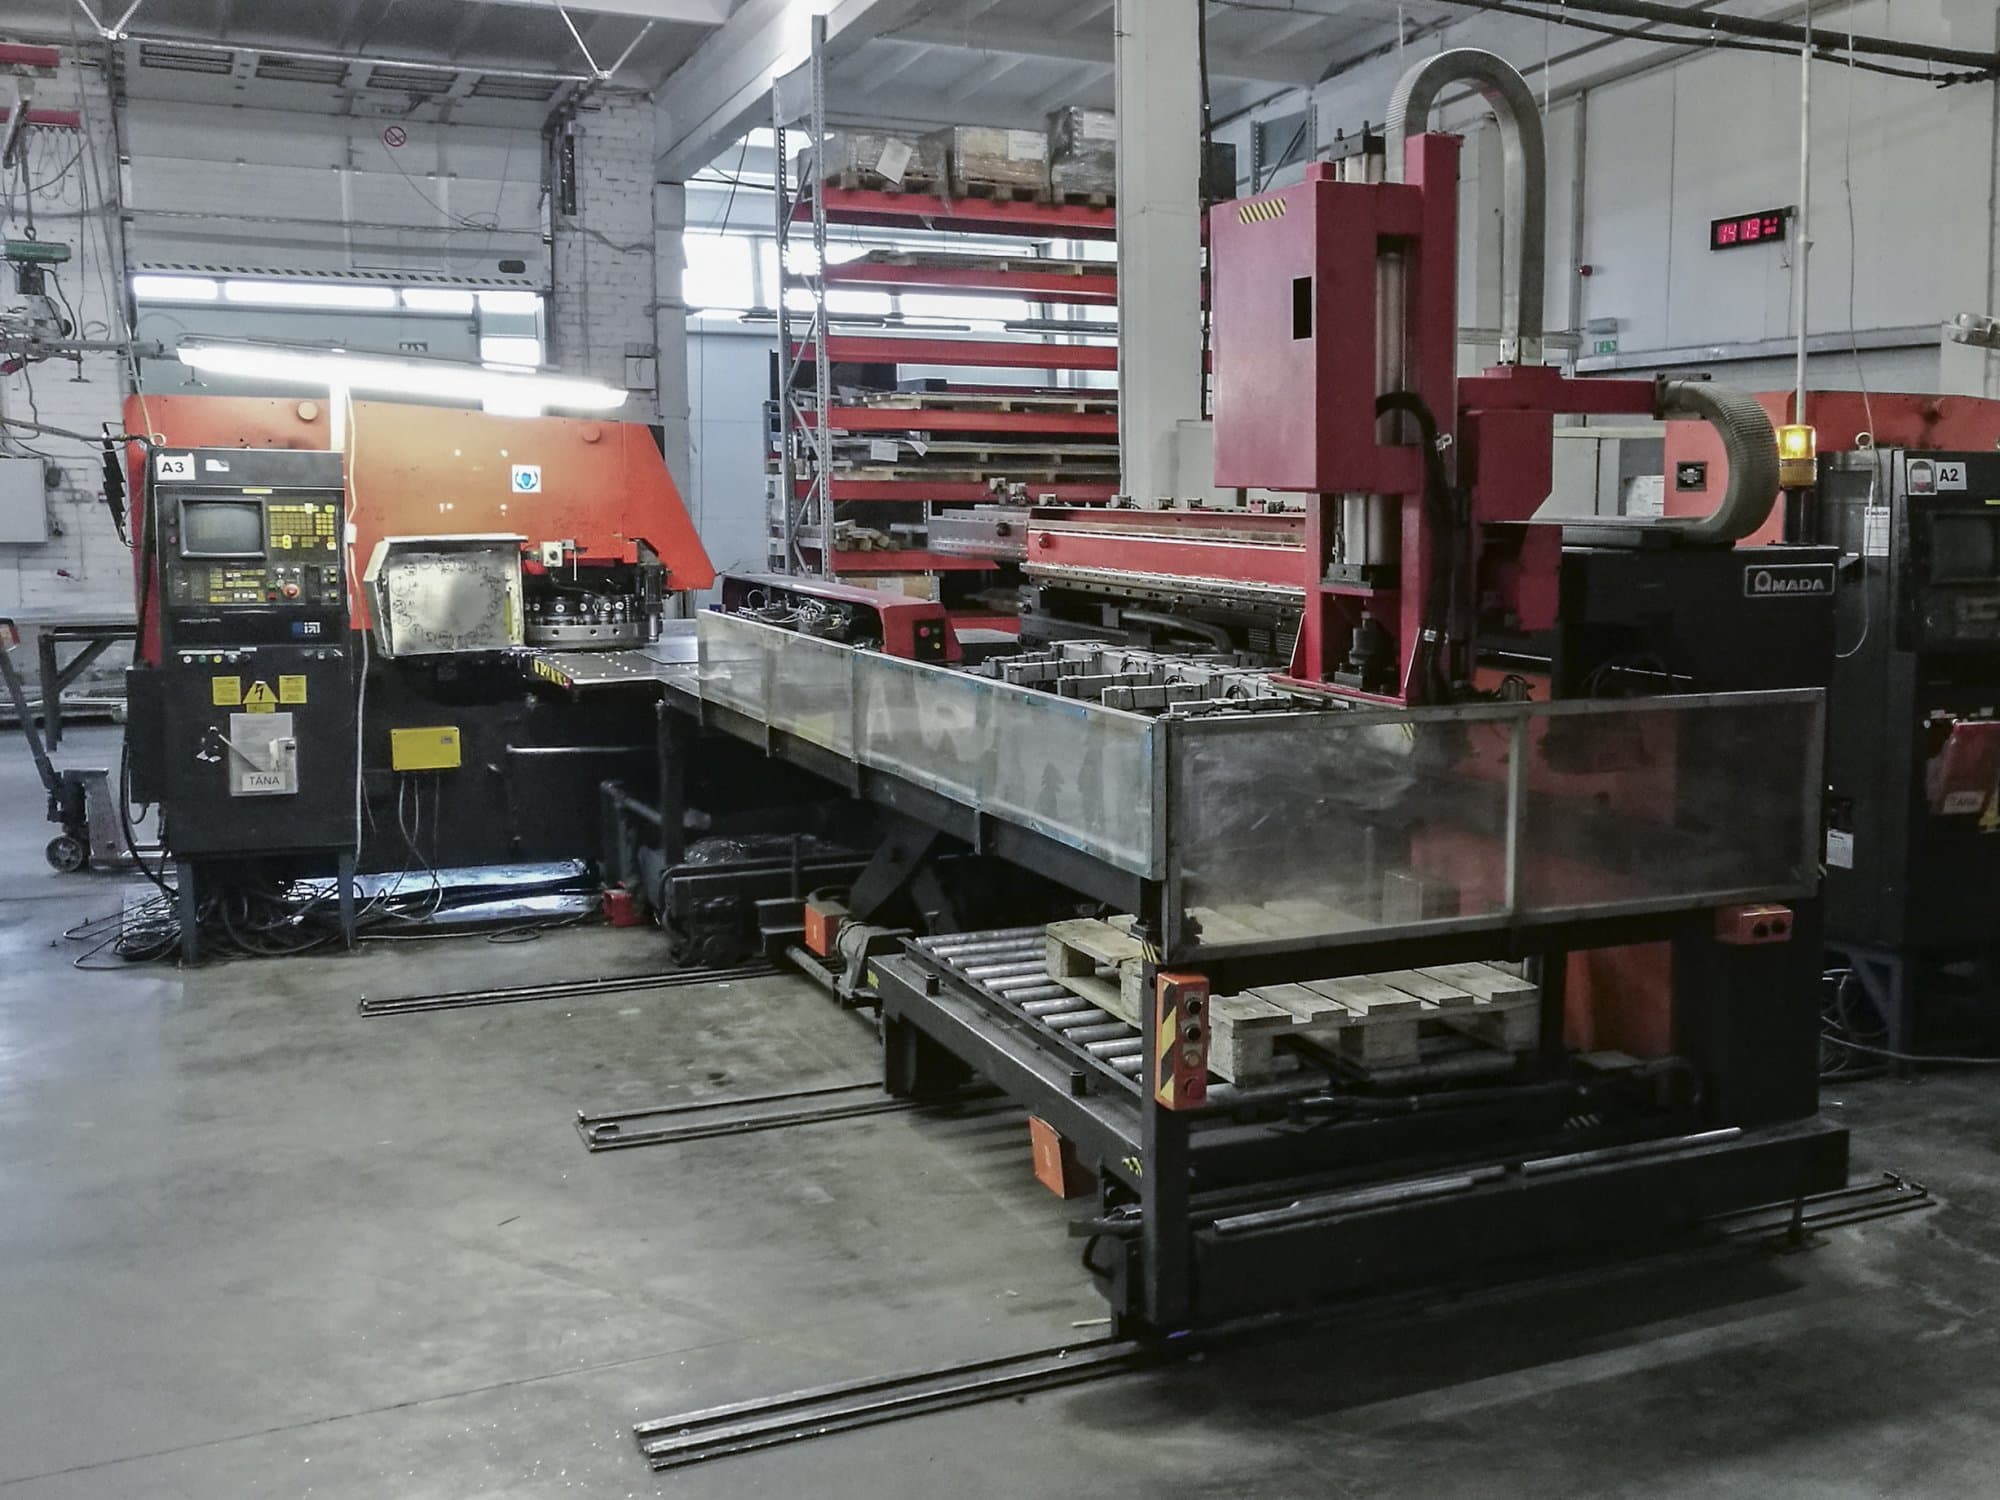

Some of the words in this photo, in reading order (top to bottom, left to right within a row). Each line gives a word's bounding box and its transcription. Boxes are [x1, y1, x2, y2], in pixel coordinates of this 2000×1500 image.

[161, 462, 184, 473] A3
[1939, 468, 1960, 482] A2
[1754, 570, 1825, 592] AMADA
[249, 776, 280, 785] TANA
